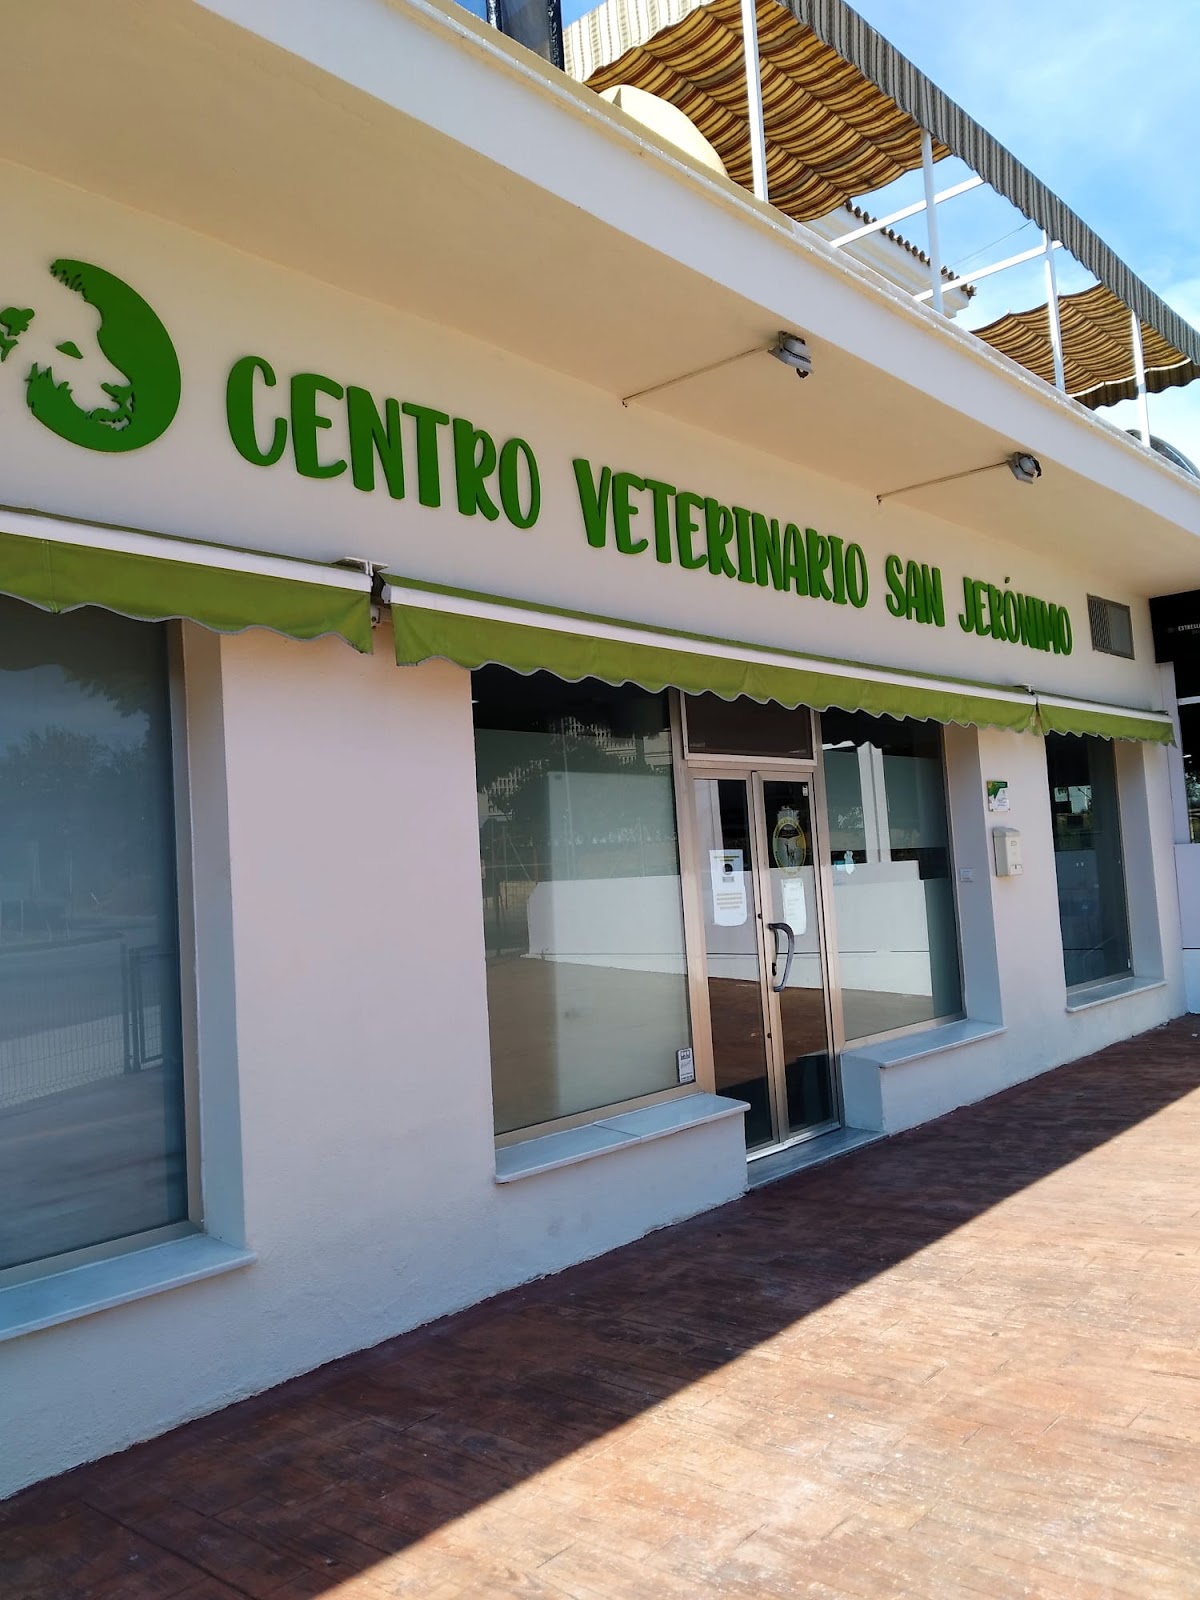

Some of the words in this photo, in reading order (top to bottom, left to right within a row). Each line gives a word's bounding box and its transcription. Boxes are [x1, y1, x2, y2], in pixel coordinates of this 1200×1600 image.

[226, 355, 541, 529] CENTRO
[572, 458, 869, 608] VETERINARIO
[885, 554, 946, 628] SAN
[958, 576, 1073, 656] JERÓNIMO
